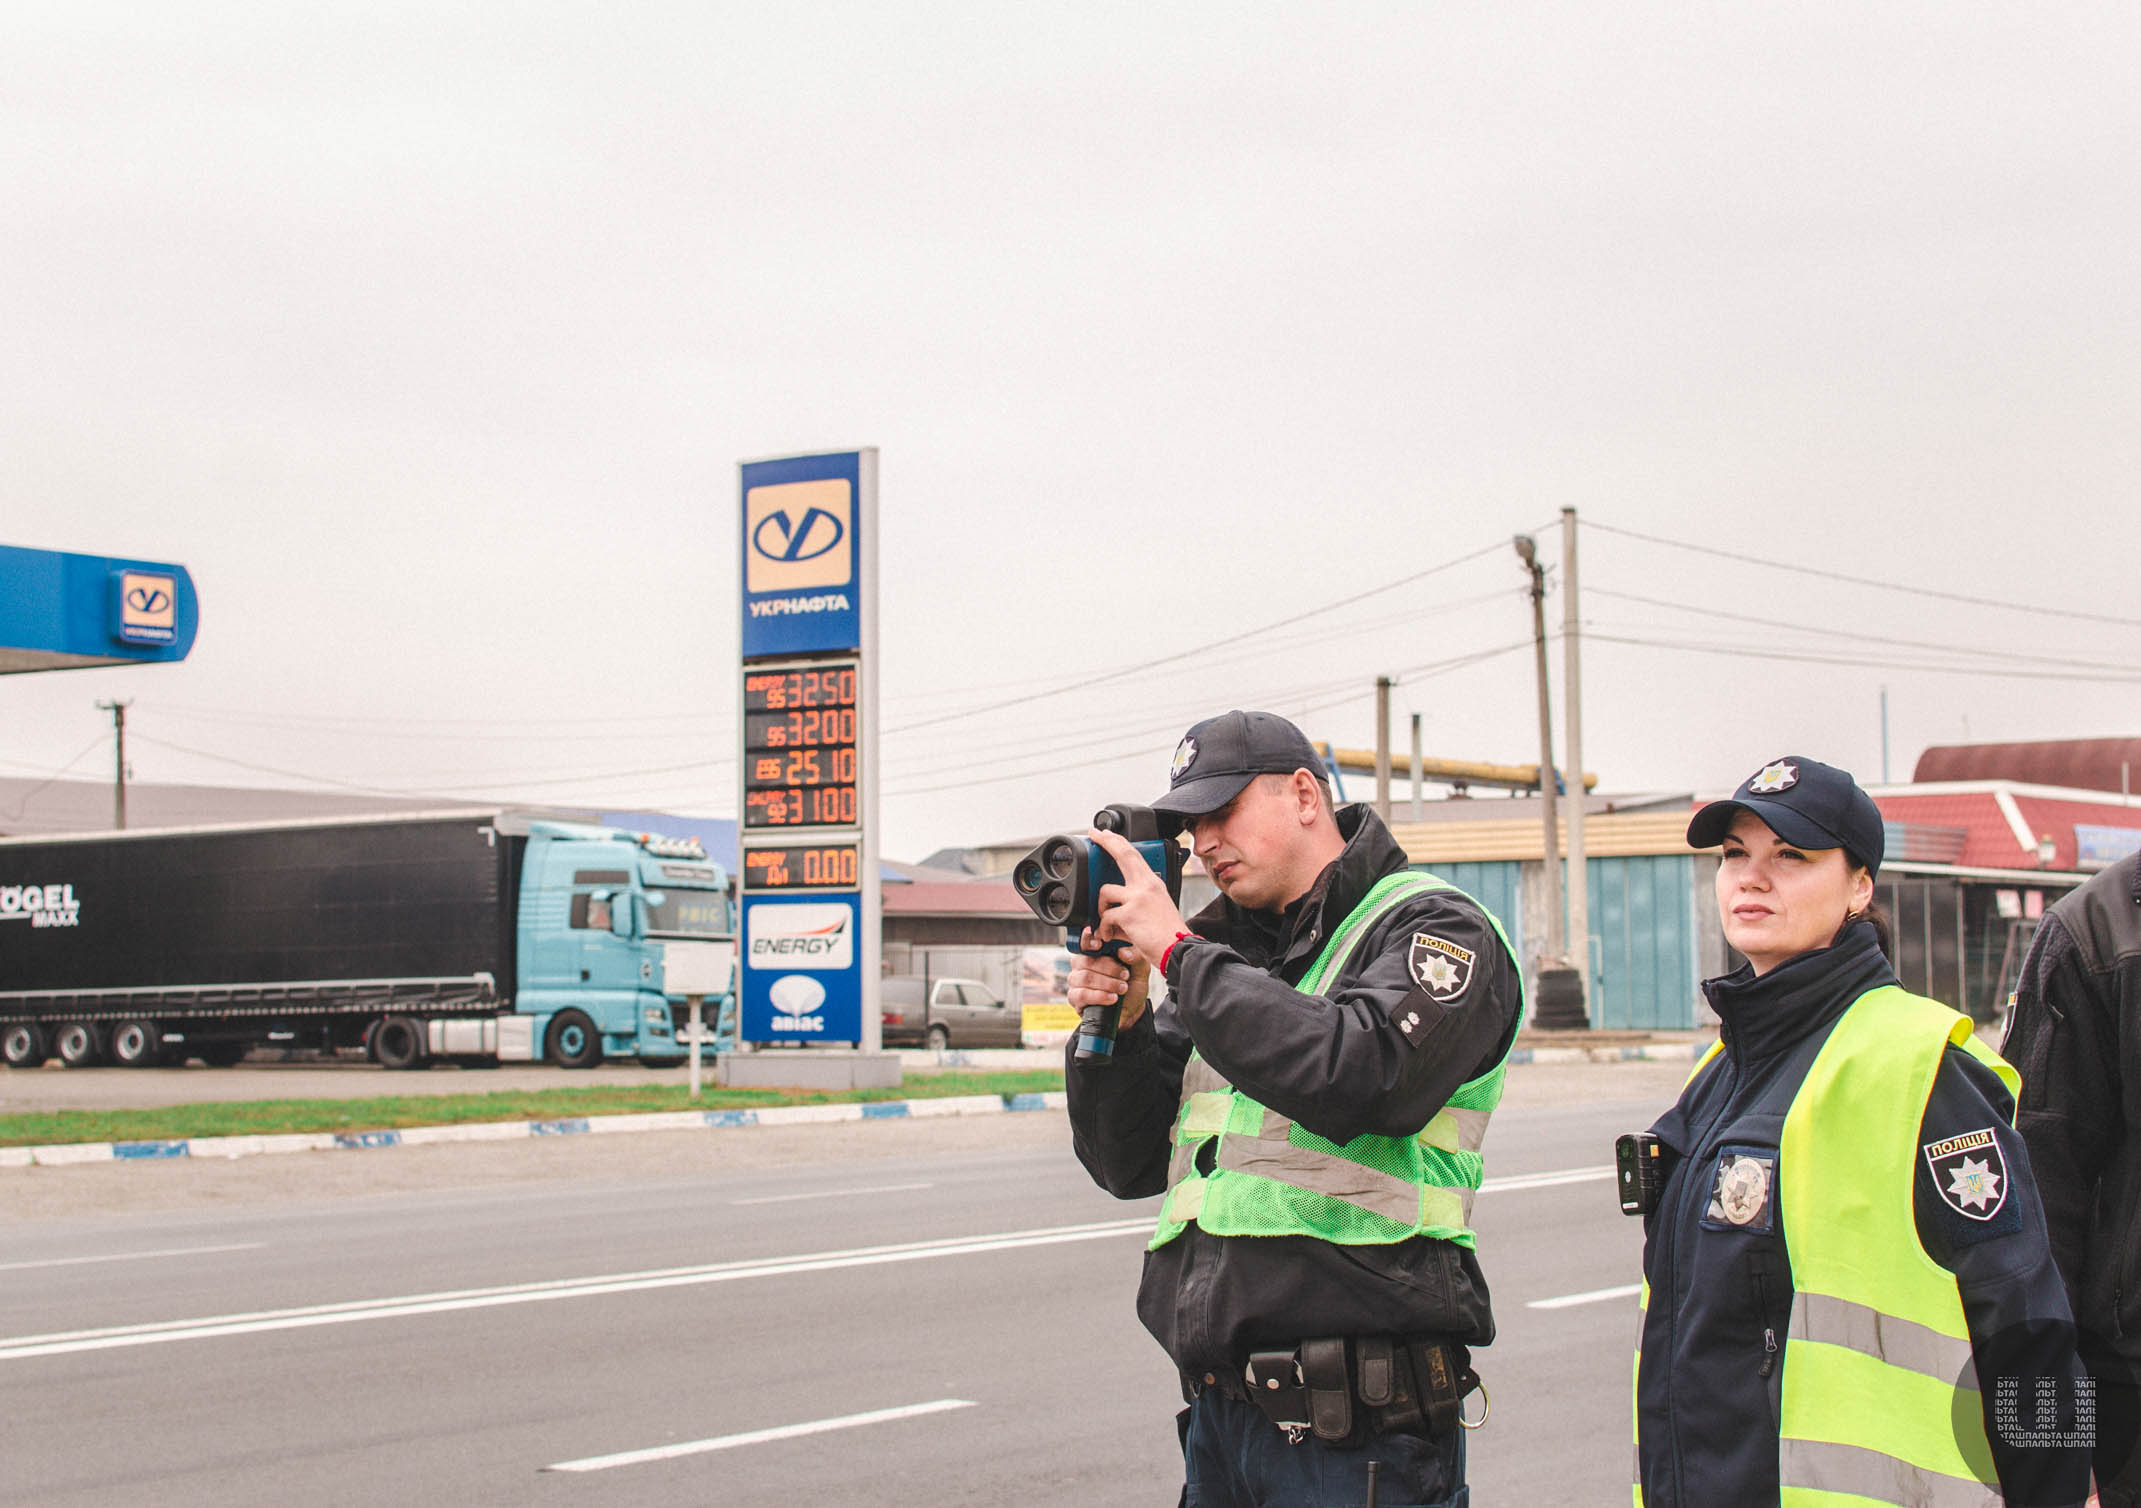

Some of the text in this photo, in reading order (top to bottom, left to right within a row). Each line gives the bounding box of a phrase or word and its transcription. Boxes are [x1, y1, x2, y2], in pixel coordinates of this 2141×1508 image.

[750, 594, 849, 618] УКРНАФТА
[767, 709, 855, 747] 95 3200
[0, 883, 80, 912] ÖGEL
[32, 911, 79, 928] MAXX
[752, 938, 839, 955] ENERGY
[1420, 937, 1468, 960] ПОЛІЦІЯ
[1931, 1132, 1990, 1157] ПОЛІЦІЯ
